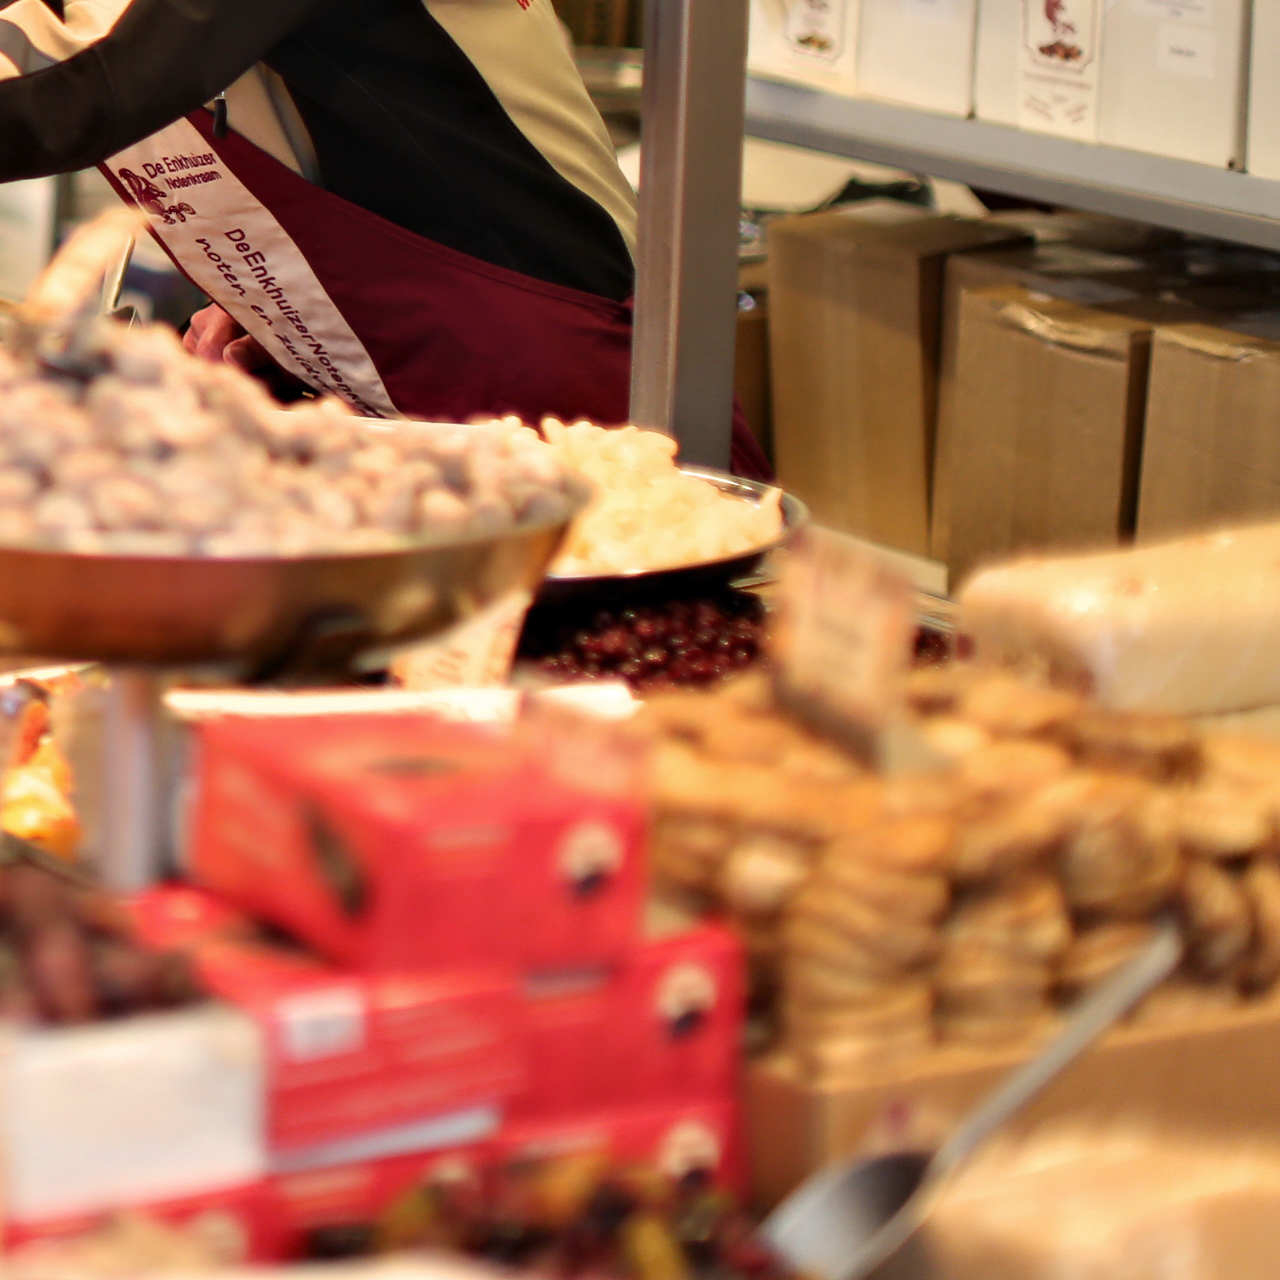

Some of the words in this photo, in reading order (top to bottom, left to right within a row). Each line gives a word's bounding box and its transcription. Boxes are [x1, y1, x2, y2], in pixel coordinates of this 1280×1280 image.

[142, 162, 166, 179] De
[162, 153, 217, 173] Enkhuizer
[164, 170, 222, 191] Notenkraam
[195, 237, 247, 297] noten
[250, 304, 274, 327] en
